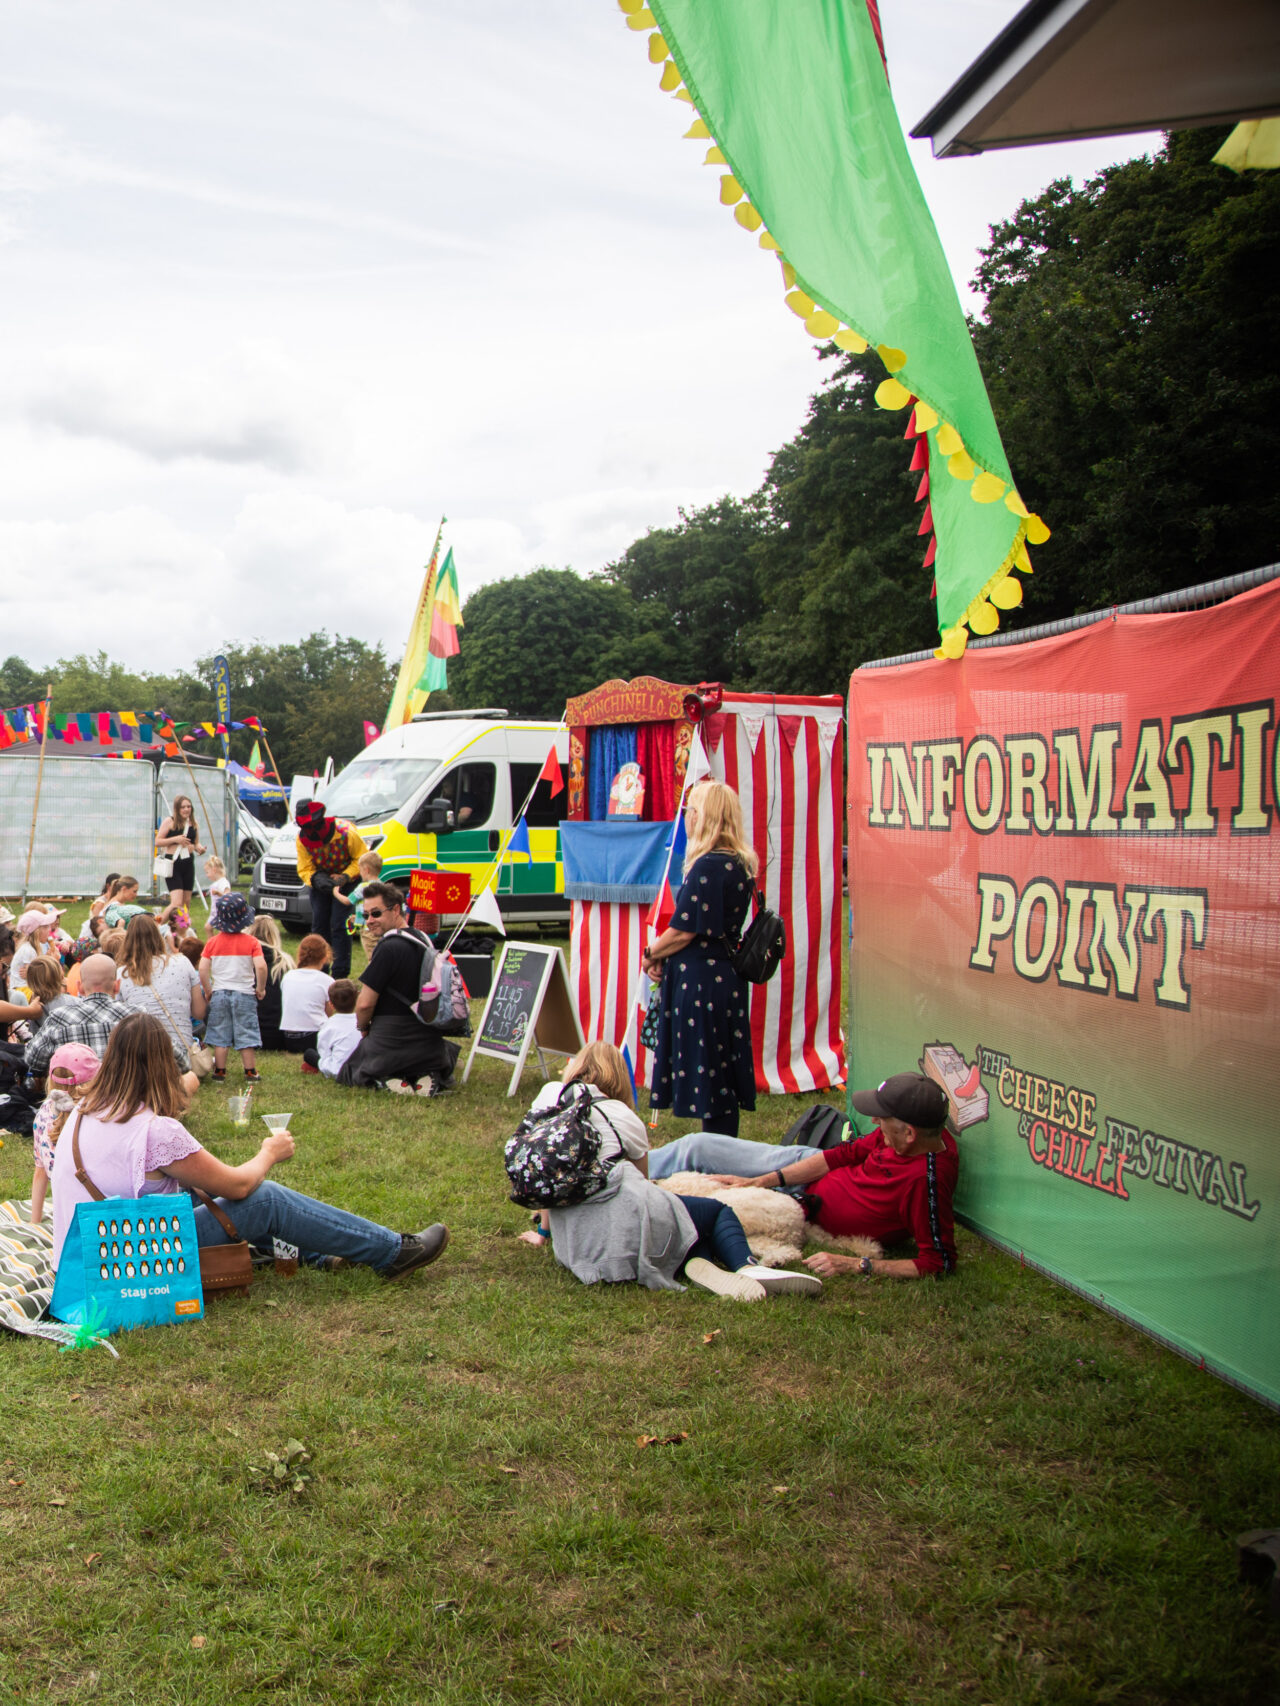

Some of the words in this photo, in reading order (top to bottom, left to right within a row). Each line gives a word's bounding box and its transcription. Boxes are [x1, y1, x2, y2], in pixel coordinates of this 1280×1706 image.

[867, 699, 1280, 836] INFORMATI
[411, 874, 435, 894] Magic
[412, 894, 432, 910] Mike
[969, 873, 1208, 1011] POINT
[980, 1048, 1011, 1079] THE
[997, 1067, 1098, 1138] CHEESE
[1019, 1113, 1032, 1138] &
[1028, 1120, 1129, 1200] CHILLI
[1104, 1117, 1260, 1221] FESTIVAL
[120, 1284, 147, 1300] Stay
[149, 1284, 170, 1297] cool
